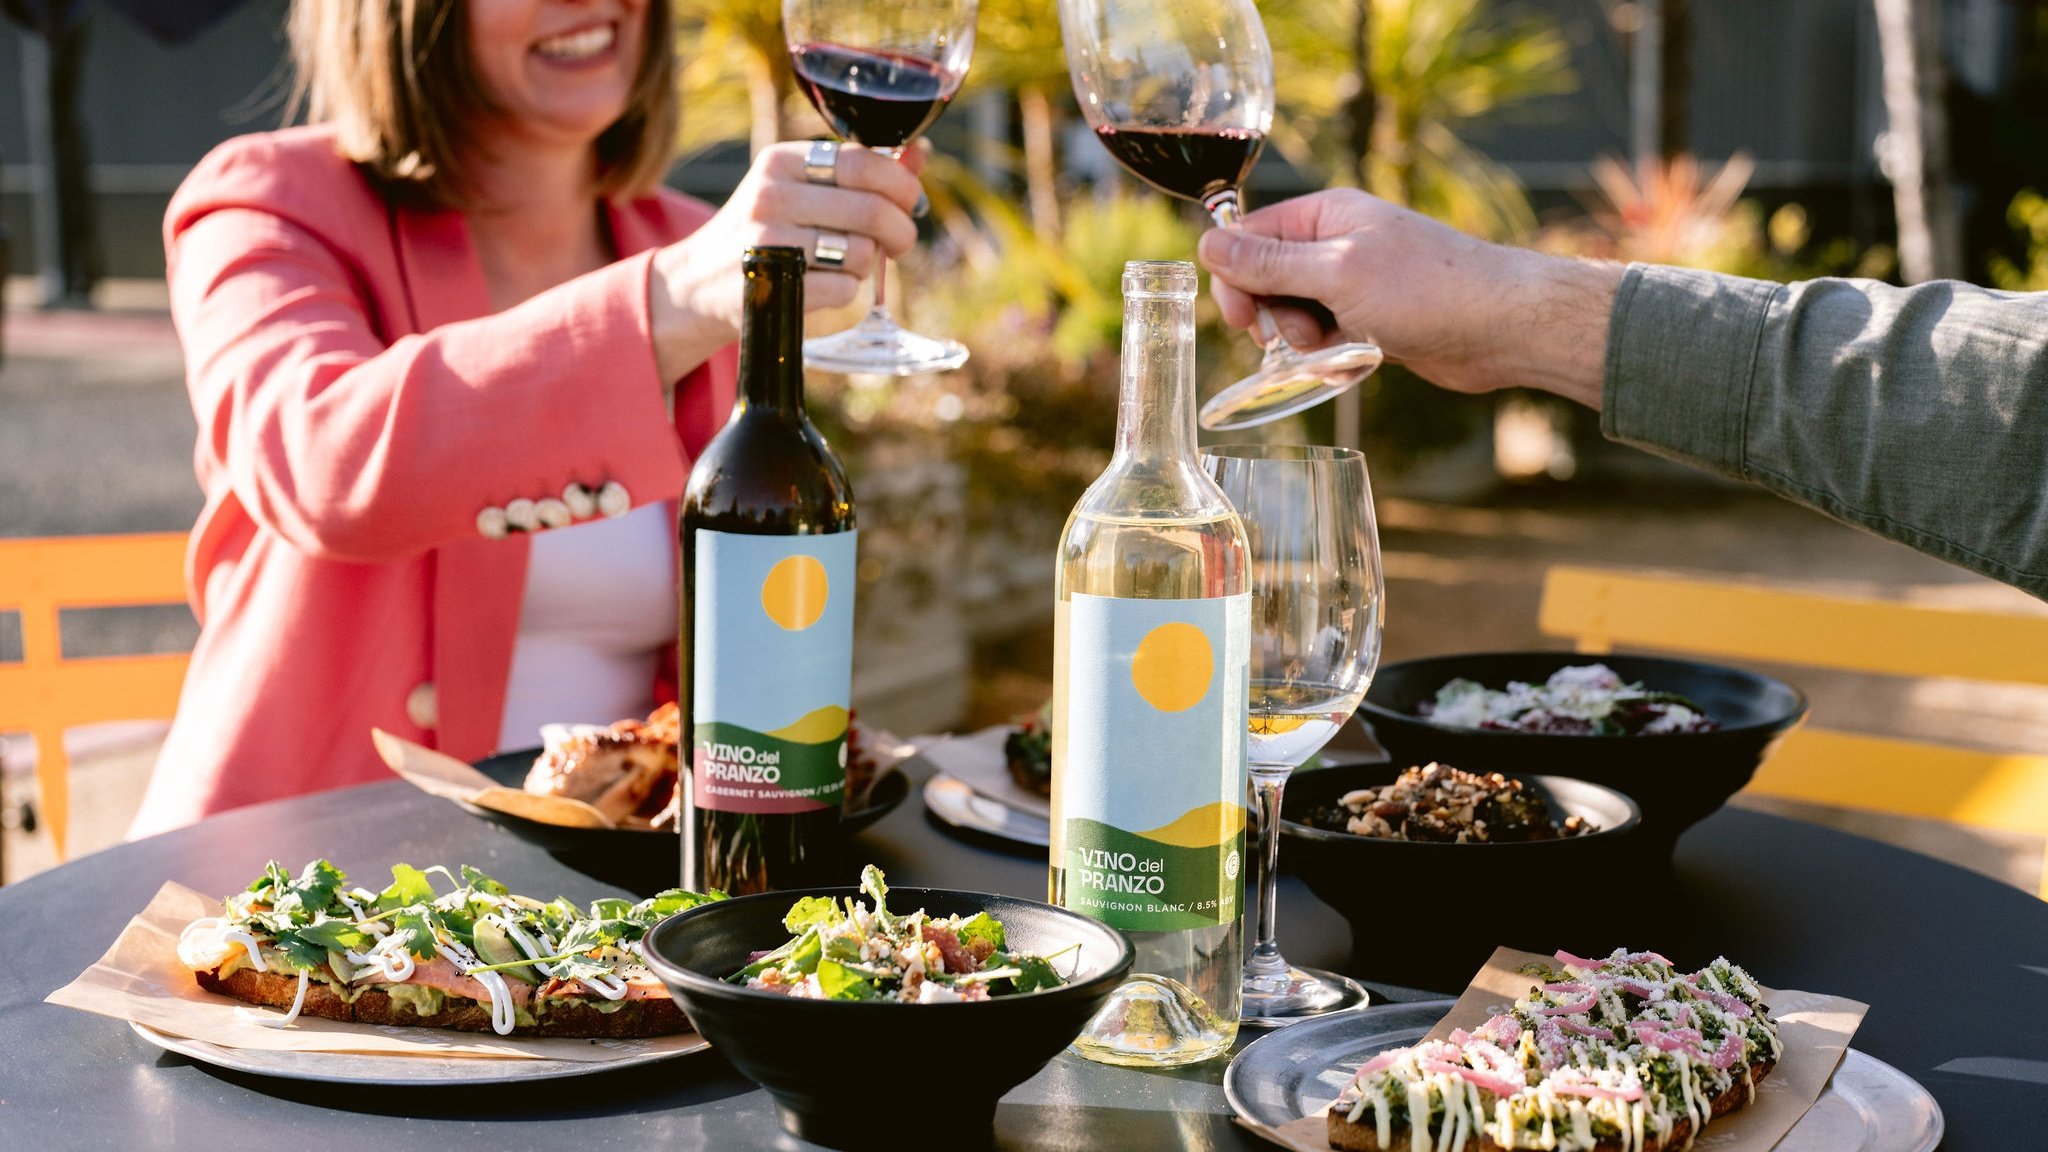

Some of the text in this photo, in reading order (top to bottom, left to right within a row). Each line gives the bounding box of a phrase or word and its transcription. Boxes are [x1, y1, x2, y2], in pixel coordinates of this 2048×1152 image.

[703, 741, 780, 765] VINO del
[703, 760, 781, 784] PRANZO
[705, 784, 756, 798] CABERNET
[757, 787, 816, 799] SAUVIGNON
[1078, 847, 1164, 873] VINO del
[1078, 868, 1165, 895] PRANZO
[1080, 897, 1143, 913] SAUVIGNON
[1146, 902, 1186, 913] BLANC
[1187, 901, 1194, 913] /
[1196, 899, 1218, 911] 8.5%
